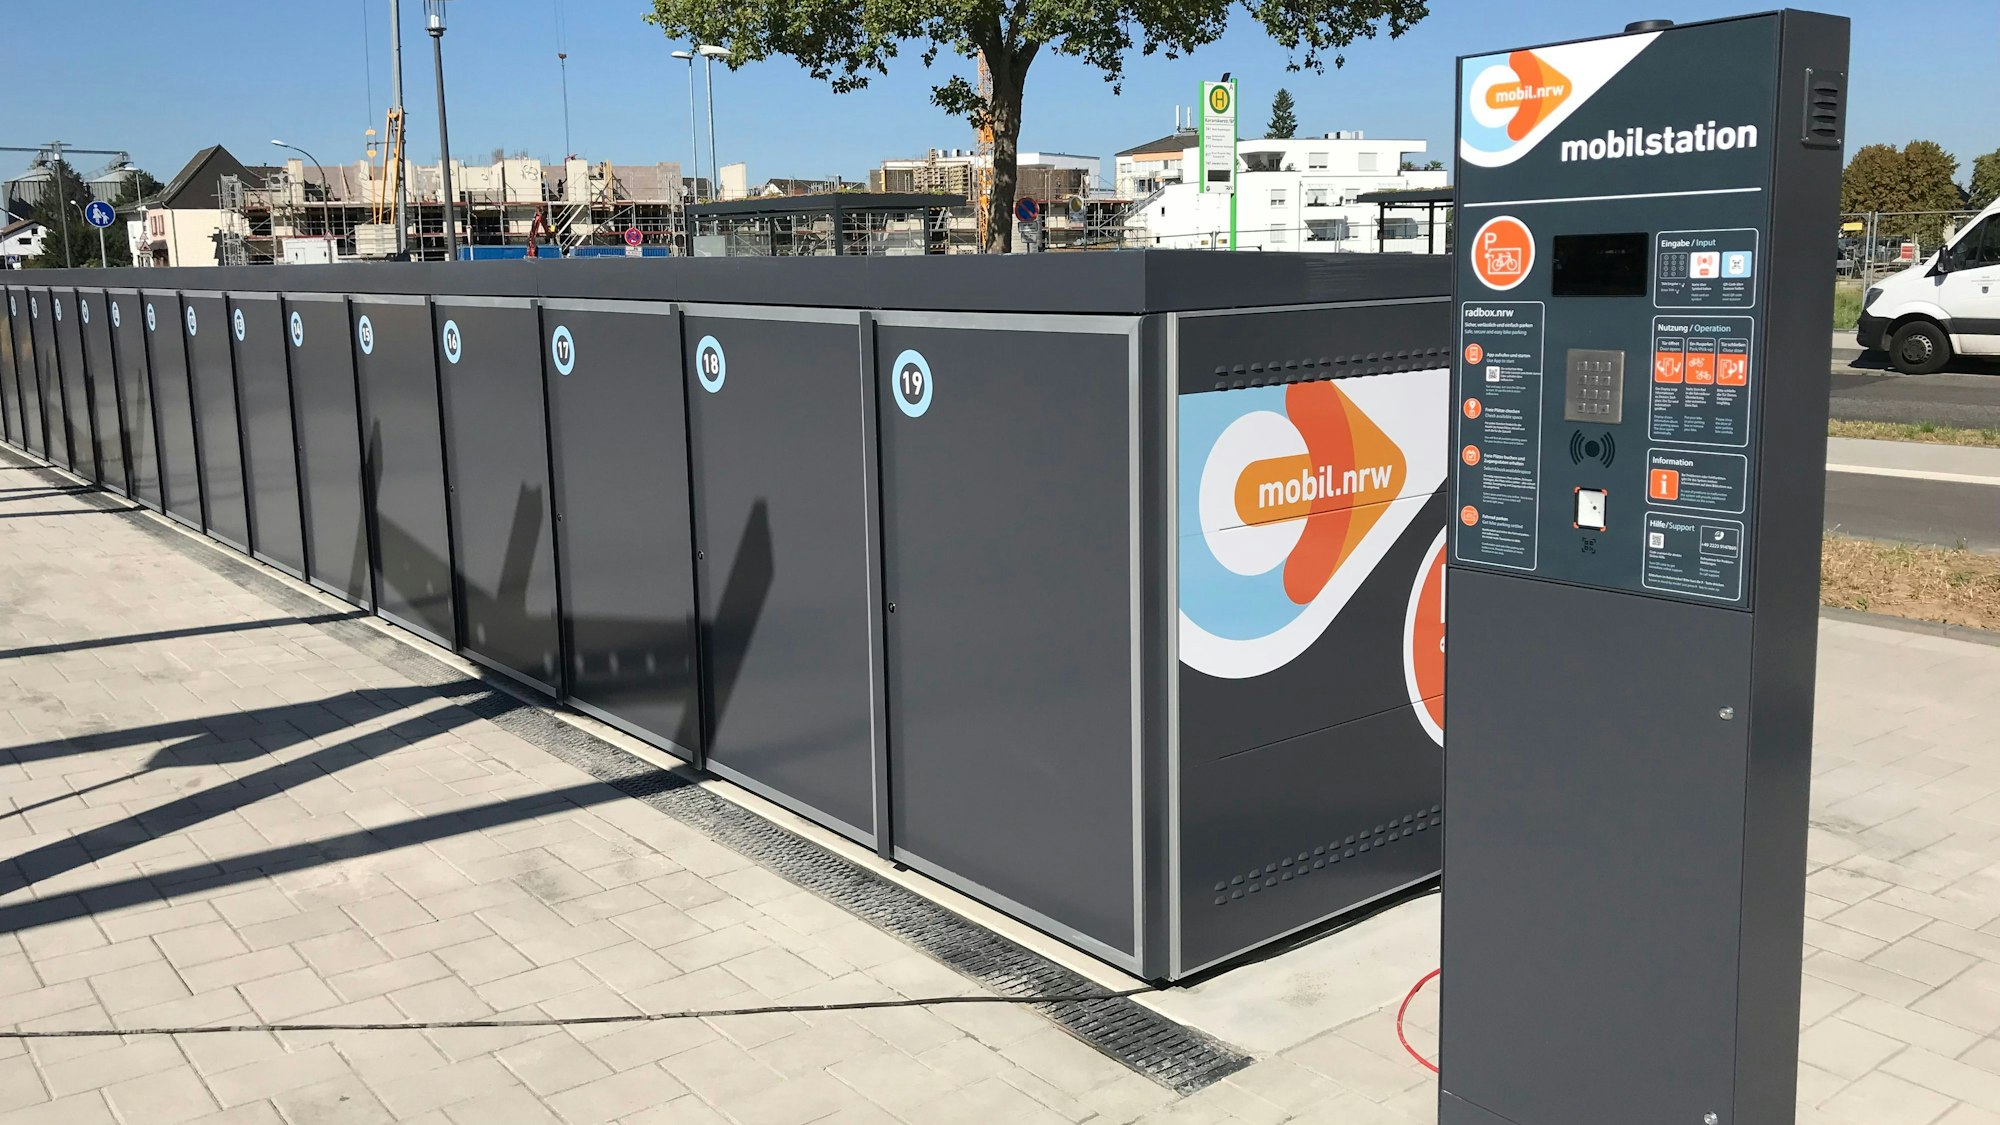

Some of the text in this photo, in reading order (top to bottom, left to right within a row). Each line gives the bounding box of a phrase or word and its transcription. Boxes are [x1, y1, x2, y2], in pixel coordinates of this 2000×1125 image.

[1216, 91, 1224, 108] H
[1495, 83, 1565, 103] mobil.nrw
[1560, 120, 1758, 162] mobilstation
[1484, 232, 1498, 250] P
[1661, 239, 1690, 249] Eingabe
[1696, 239, 1716, 247] Input
[1465, 307, 1514, 317] radbox.nrw
[362, 327, 370, 342] 15
[1658, 324, 1688, 333] Nutzung
[1694, 324, 1732, 333] Operation
[448, 333, 457, 350] 16
[558, 341, 569, 359] 17
[703, 353, 718, 374] 18
[902, 370, 922, 395] 19
[1652, 456, 1694, 467] Information
[1258, 464, 1393, 508] mobil.nrw
